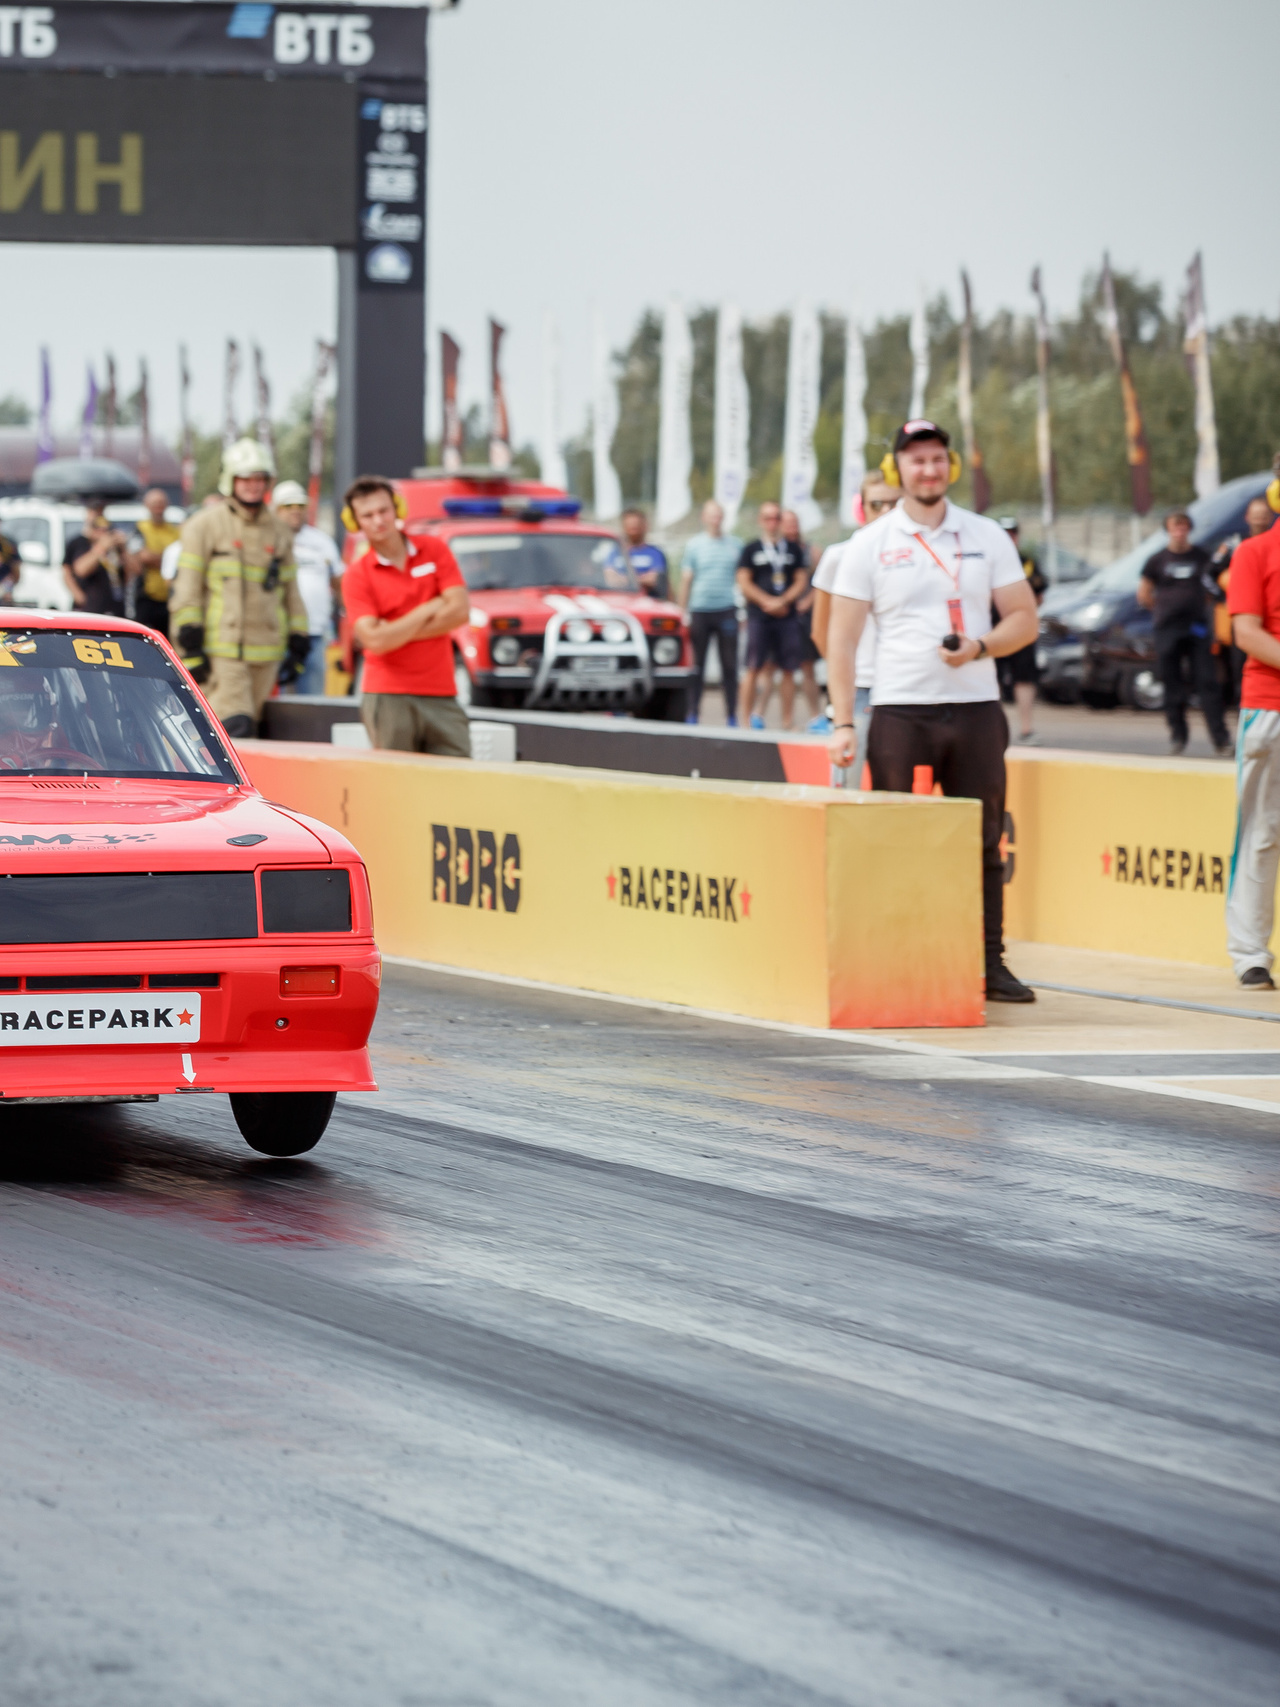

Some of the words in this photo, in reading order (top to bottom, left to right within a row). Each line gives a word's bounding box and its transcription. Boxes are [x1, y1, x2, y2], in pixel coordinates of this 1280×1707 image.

[273, 14, 374, 65] ВТБ
[72, 638, 134, 669] 61
[431, 823, 521, 914] RDRC
[1116, 846, 1226, 894] RACEPAR
[620, 866, 737, 922] RACEPARK
[0, 1008, 174, 1031] RACEPARK
